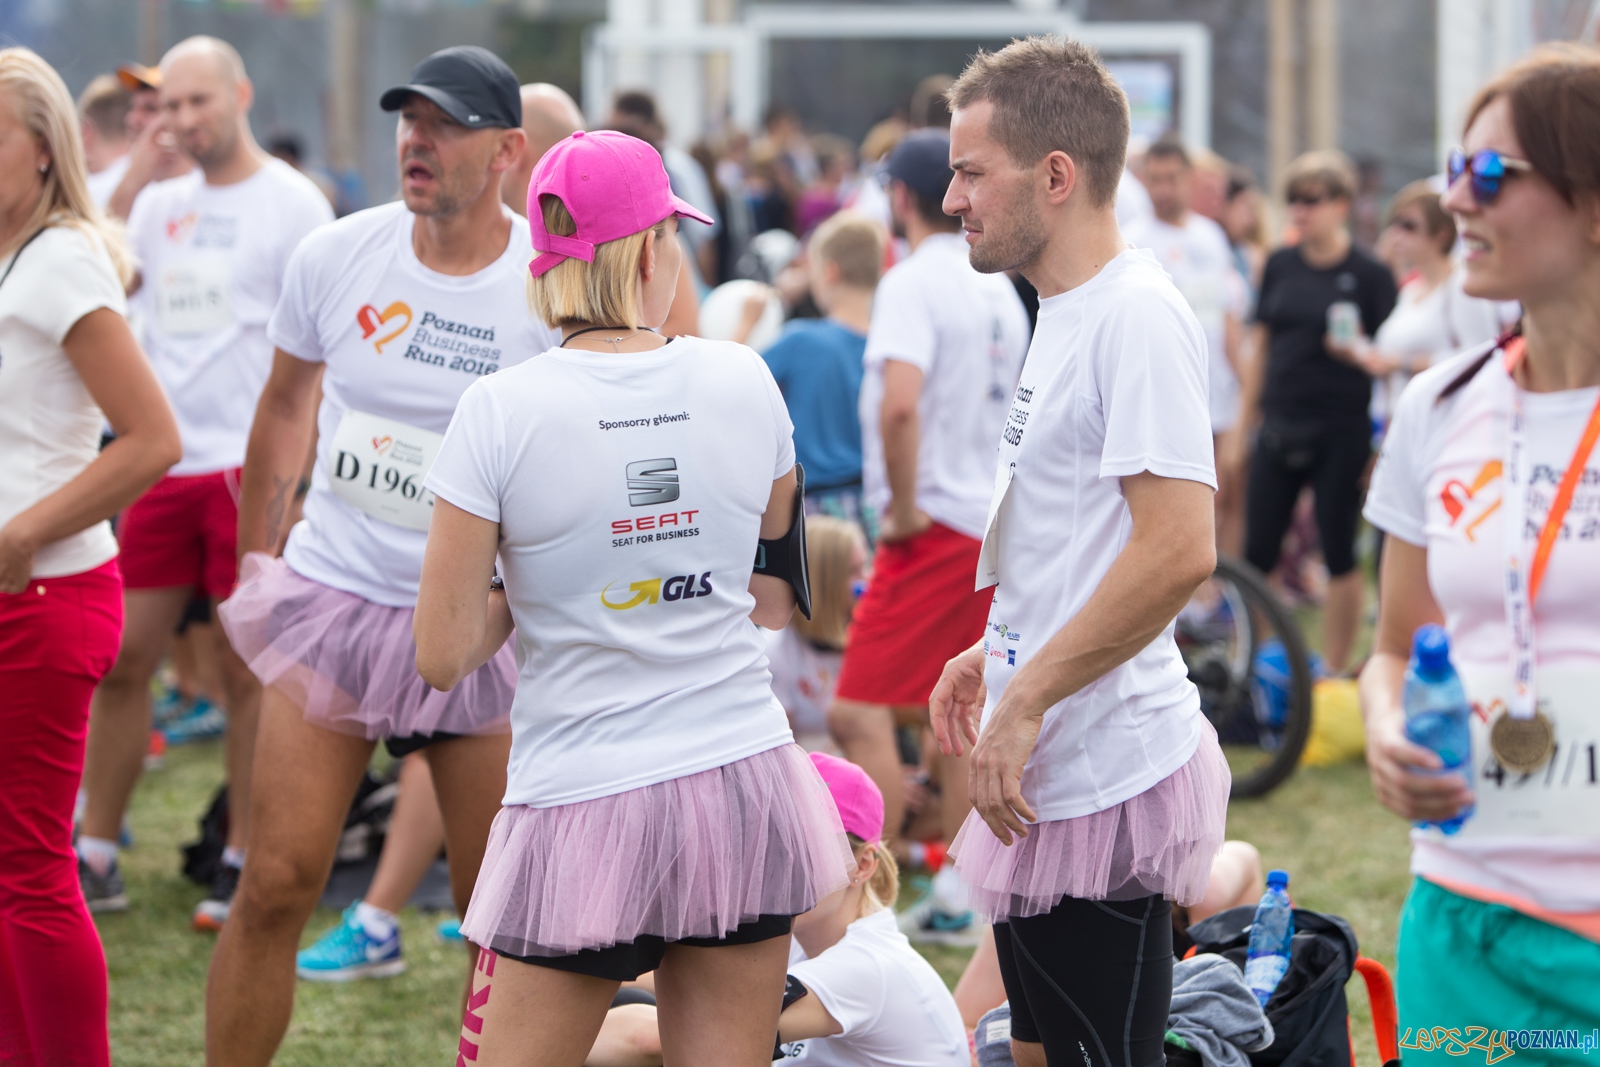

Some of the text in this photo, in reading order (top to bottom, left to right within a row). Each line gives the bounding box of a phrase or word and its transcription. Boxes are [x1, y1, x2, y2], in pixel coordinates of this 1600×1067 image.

[420, 311, 495, 341] Poznań
[412, 328, 501, 360] Business
[404, 344, 499, 376] Run 2016
[598, 411, 691, 431] Sponsorzy główni:
[335, 449, 434, 507] D 196/
[611, 509, 699, 534] SEAT
[612, 527, 700, 547] SEAT FOR BUSINESS
[662, 571, 713, 602] GLS
